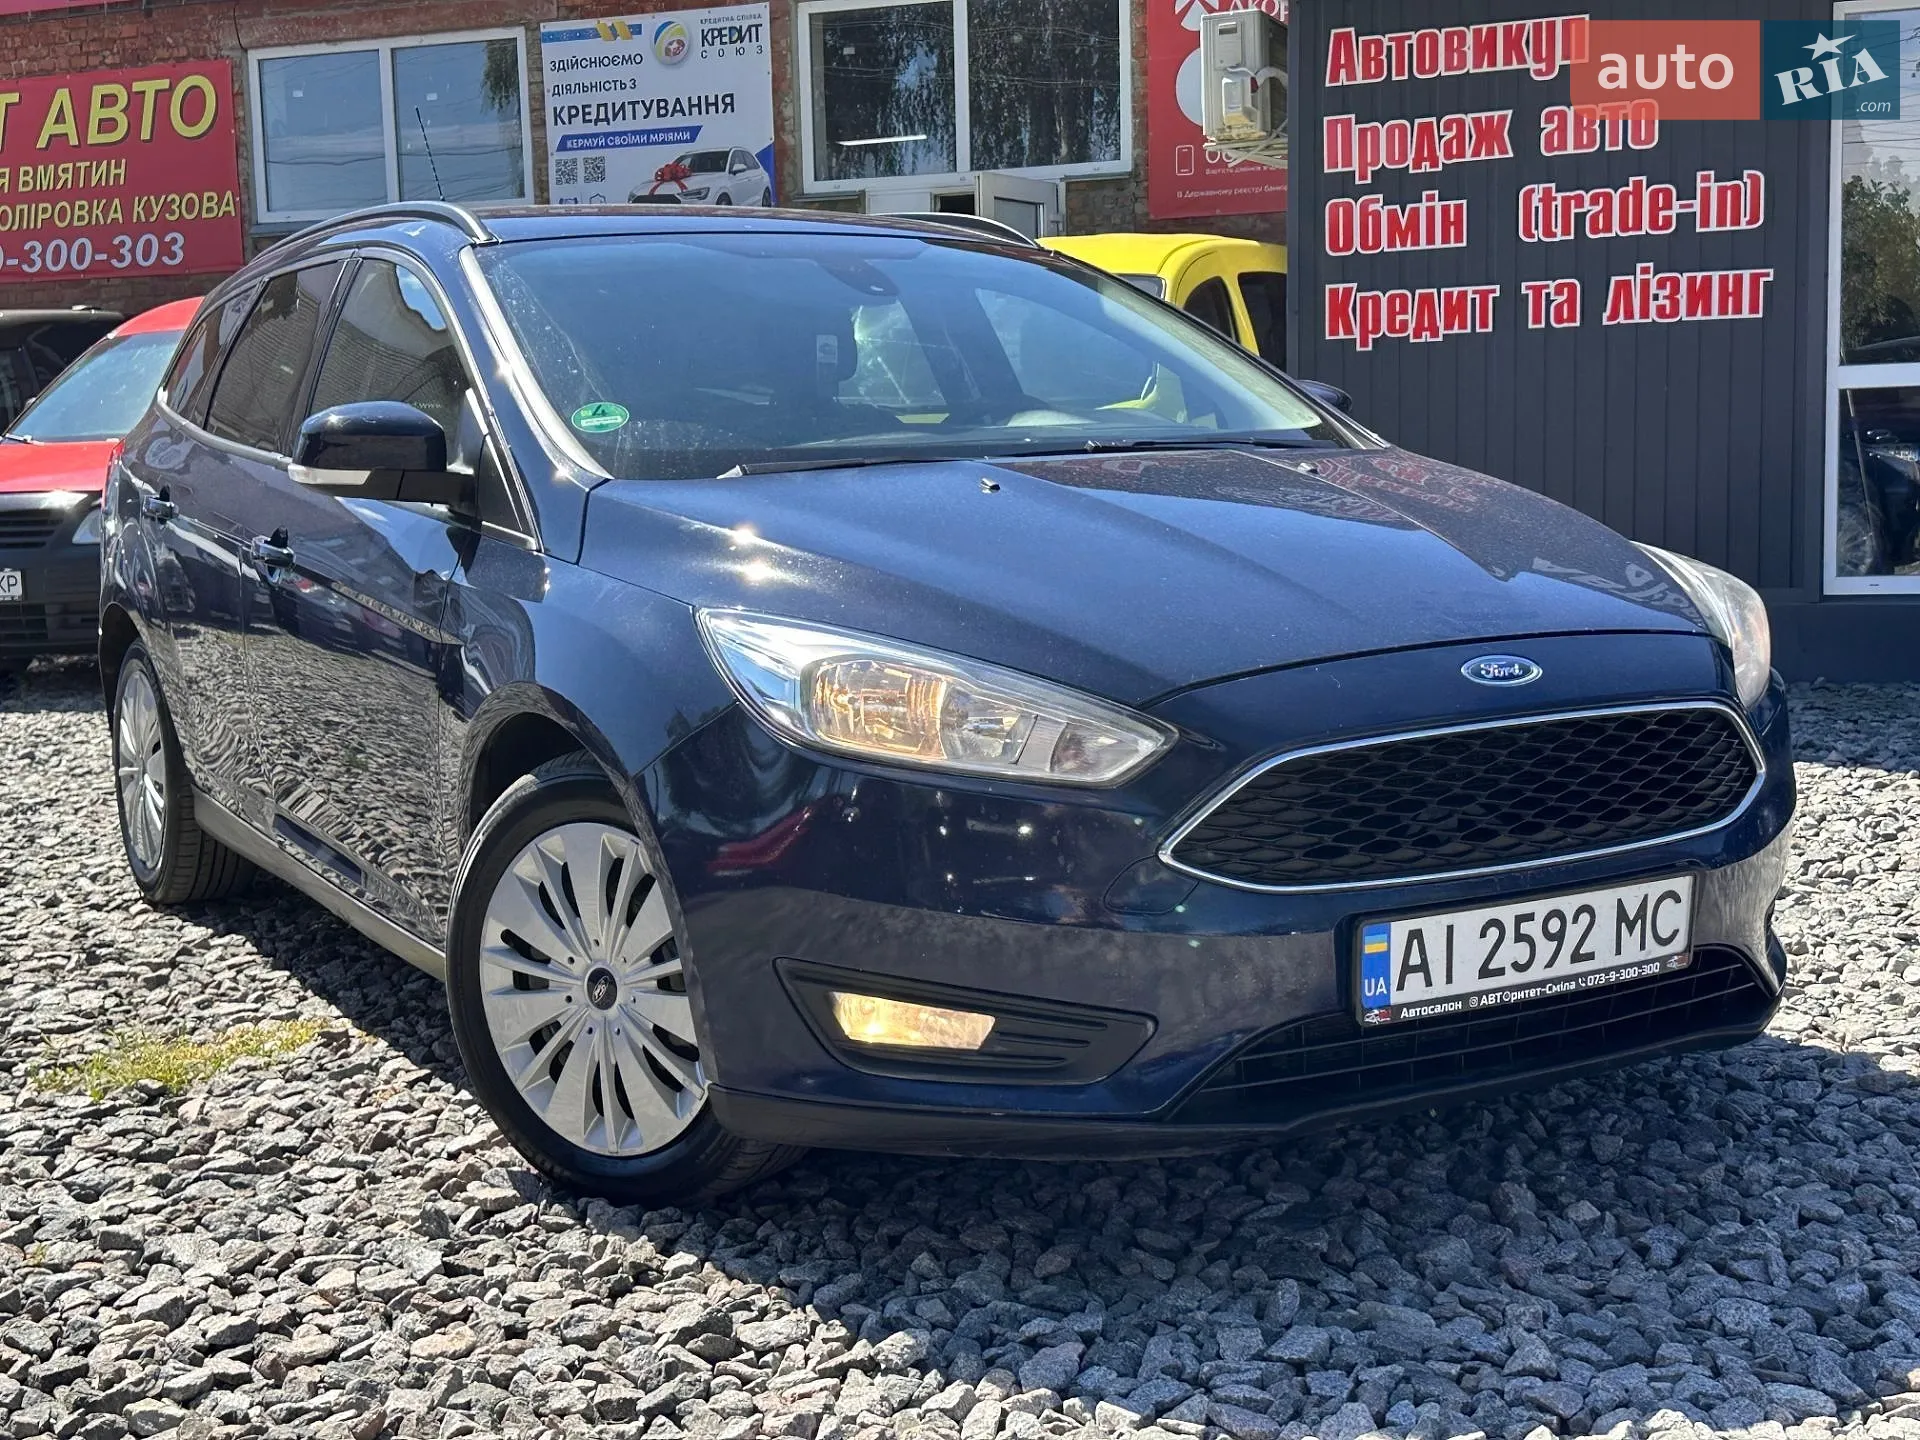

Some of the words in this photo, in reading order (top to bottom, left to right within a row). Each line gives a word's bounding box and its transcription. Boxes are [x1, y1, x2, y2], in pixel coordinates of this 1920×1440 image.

[550, 53, 643, 73] ЗДІЙСНЮЄМО
[1325, 14, 1590, 87] Автовикуп
[552, 79, 629, 97] ДІЯЛЬНІСТЬ
[630, 78, 637, 89] З
[36, 75, 217, 150] АВТО
[553, 93, 735, 126] КРЕДИТУВАННЯ
[567, 136, 606, 149] КЕРМУЙ
[607, 133, 648, 146] СВОЇМИ
[650, 131, 690, 143] МРІЯМИ
[1323, 109, 1514, 184] Продаж
[1540, 99, 1659, 156] авто
[18, 159, 126, 192] ВМЯТИН
[0, 198, 123, 231] ОЛІРОВКА
[133, 190, 236, 223] КУЗОВА
[1325, 191, 1467, 257] Обмін
[1519, 169, 1764, 243] (trade-in)
[0, 231, 185, 274] -300-303
[1325, 282, 1500, 351] Кредит
[1521, 278, 1581, 329] та
[1602, 262, 1774, 326] лізинг
[1480, 661, 1523, 678] Ford
[1396, 924, 1455, 992] AI
[1478, 904, 1597, 980] 2592
[1614, 889, 1682, 957] MC
[1364, 976, 1387, 997] UA
[1400, 999, 1462, 1019] Автосалон
[1587, 961, 1660, 986] 073-9-300-300
